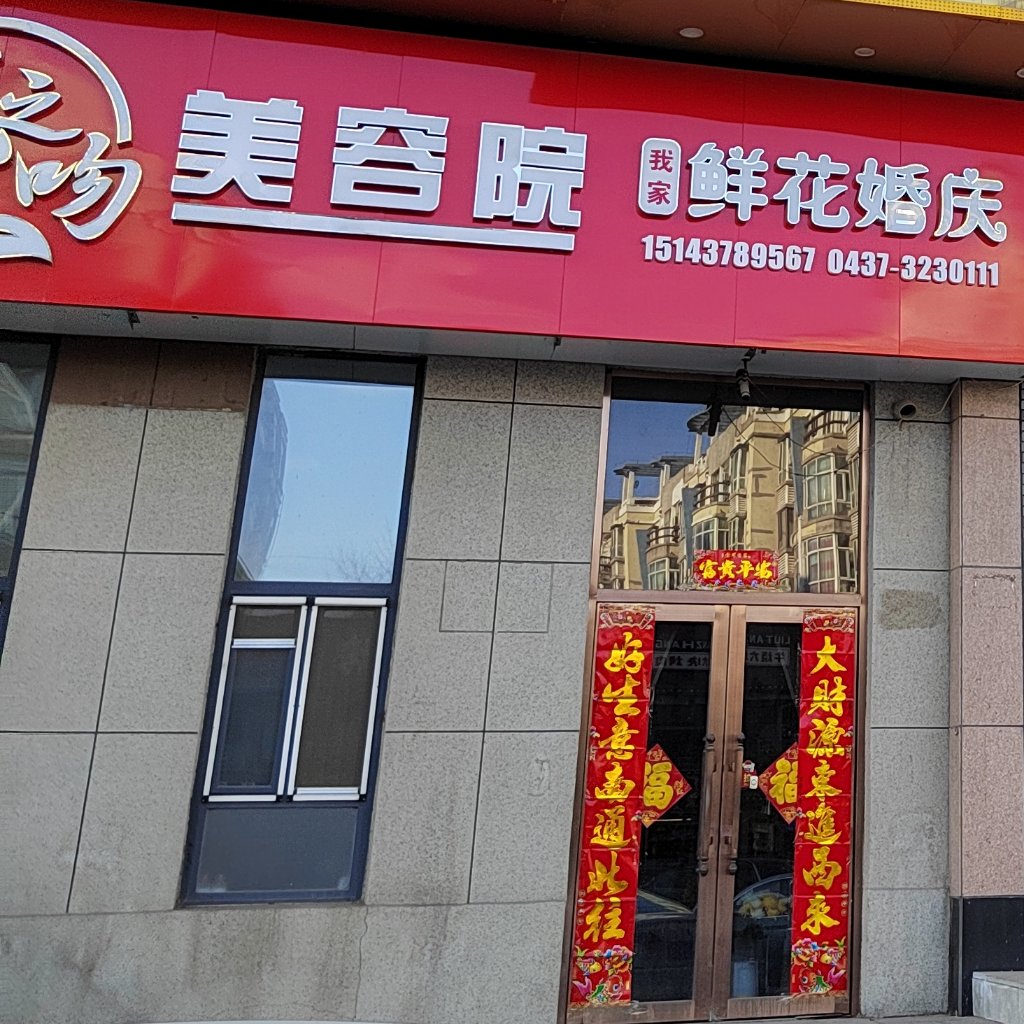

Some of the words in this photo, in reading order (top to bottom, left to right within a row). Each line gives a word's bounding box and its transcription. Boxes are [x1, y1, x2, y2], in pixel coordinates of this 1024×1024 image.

[171, 89, 588, 228] 美容院
[646, 148, 673, 207] 我家
[687, 142, 1008, 243] 鲜花婚庆
[641, 234, 816, 273] 15143789567
[826, 248, 1000, 287] 0437-3230111
